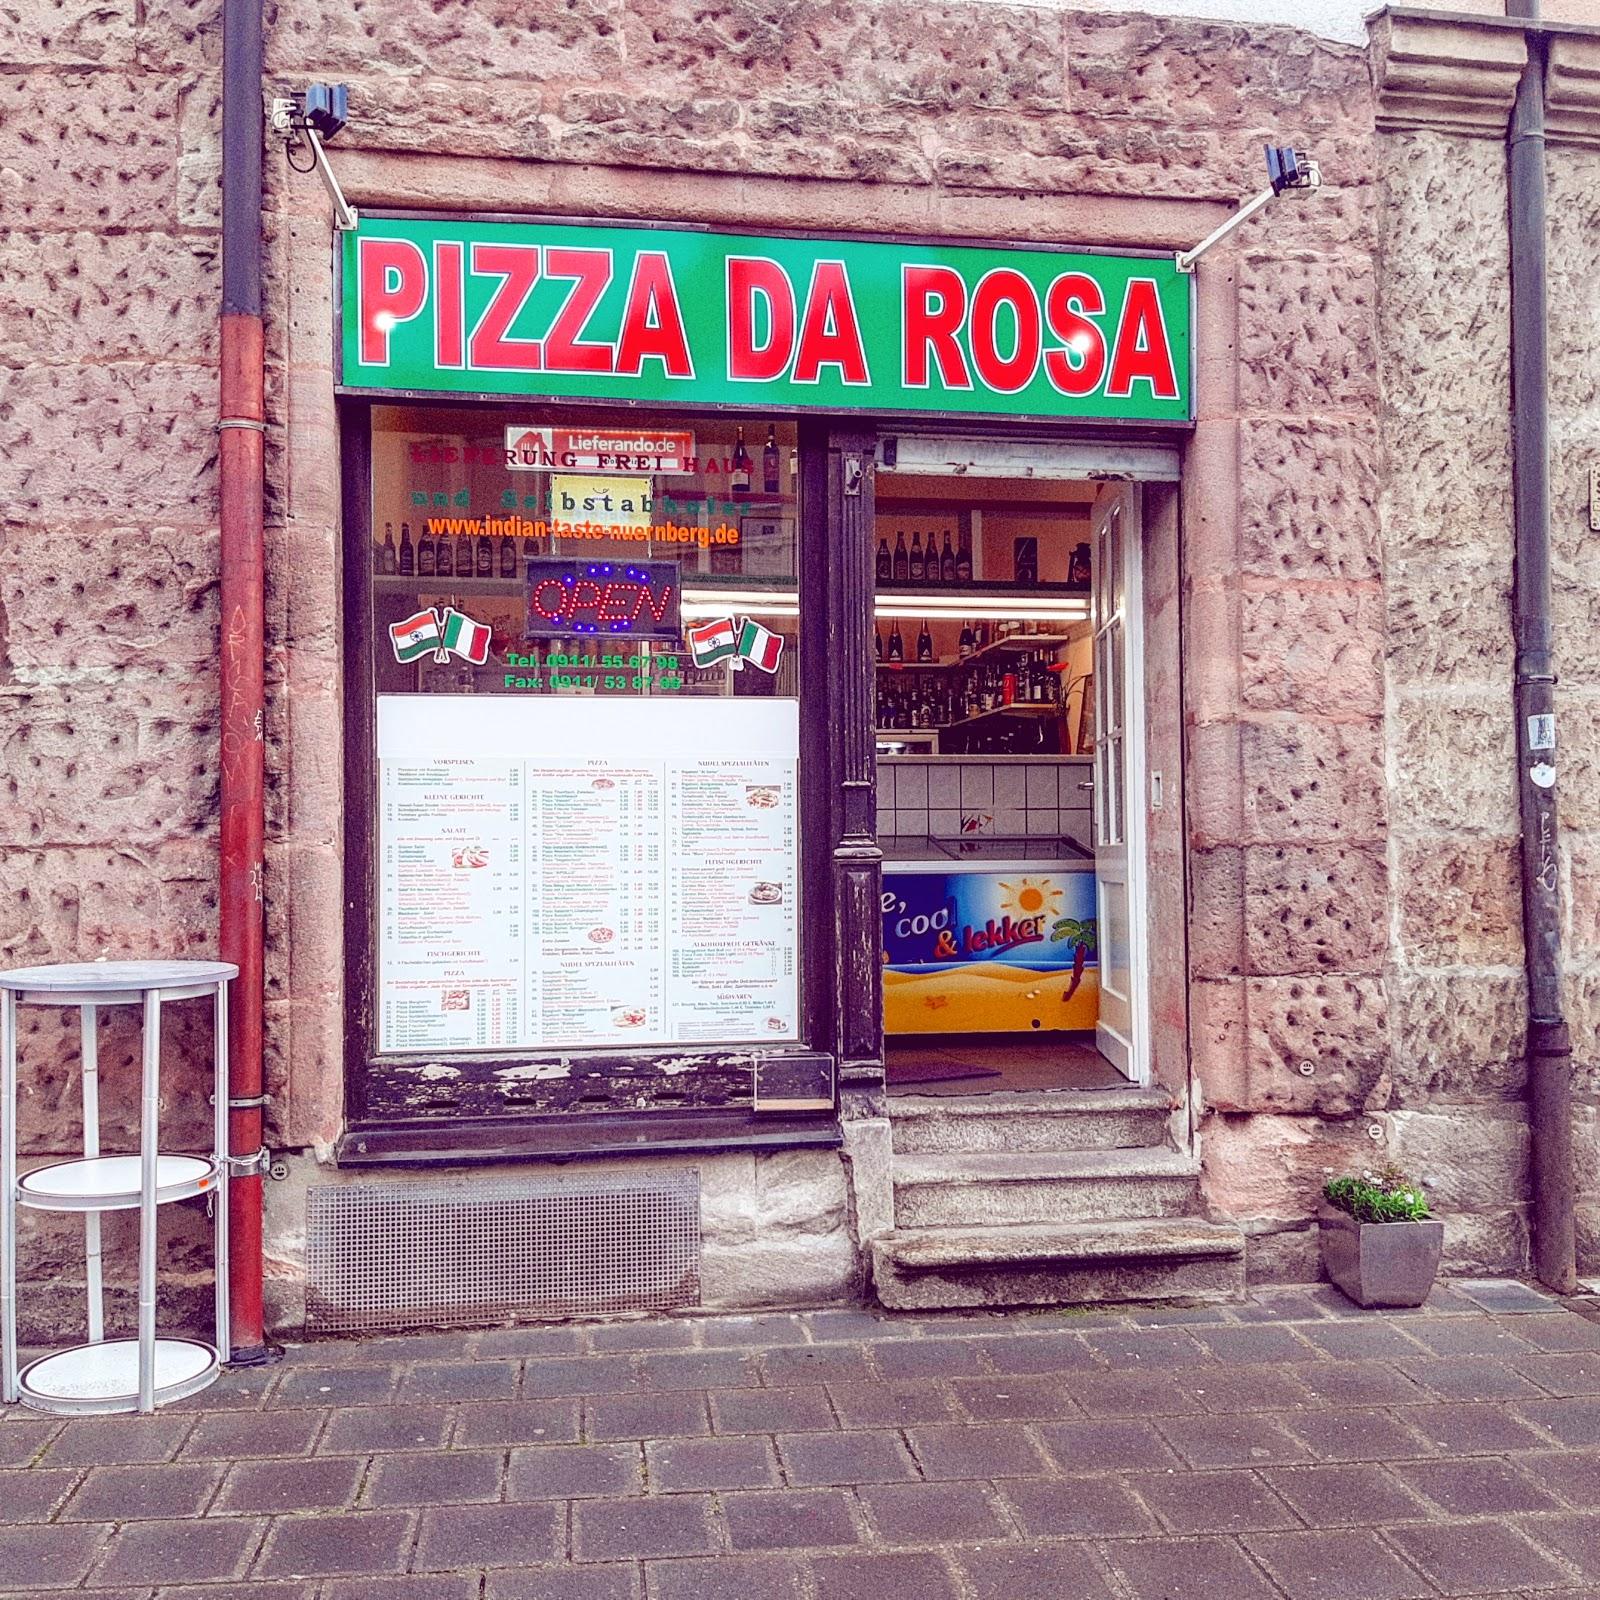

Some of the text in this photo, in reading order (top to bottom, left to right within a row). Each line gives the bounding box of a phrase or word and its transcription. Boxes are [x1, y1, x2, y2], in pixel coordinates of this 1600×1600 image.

[357, 236, 1180, 399] PIZZA DA ROSA
[410, 444, 578, 467] LIEFERUNG
[597, 453, 663, 471] FREI
[682, 456, 755, 475] HAUS
[568, 435, 676, 453] Lieferando.de
[411, 487, 470, 508] und
[427, 514, 739, 549] www.indian-taste-nuernberg.de
[534, 579, 672, 621] OPEN
[506, 653, 679, 670] Tel. 0911/ 55 67 98
[504, 674, 543, 689] Fax:
[549, 674, 599, 689] 0911/
[604, 675, 626, 689] 53
[631, 676, 653, 690] 87
[934, 914, 1046, 958] & lekker
